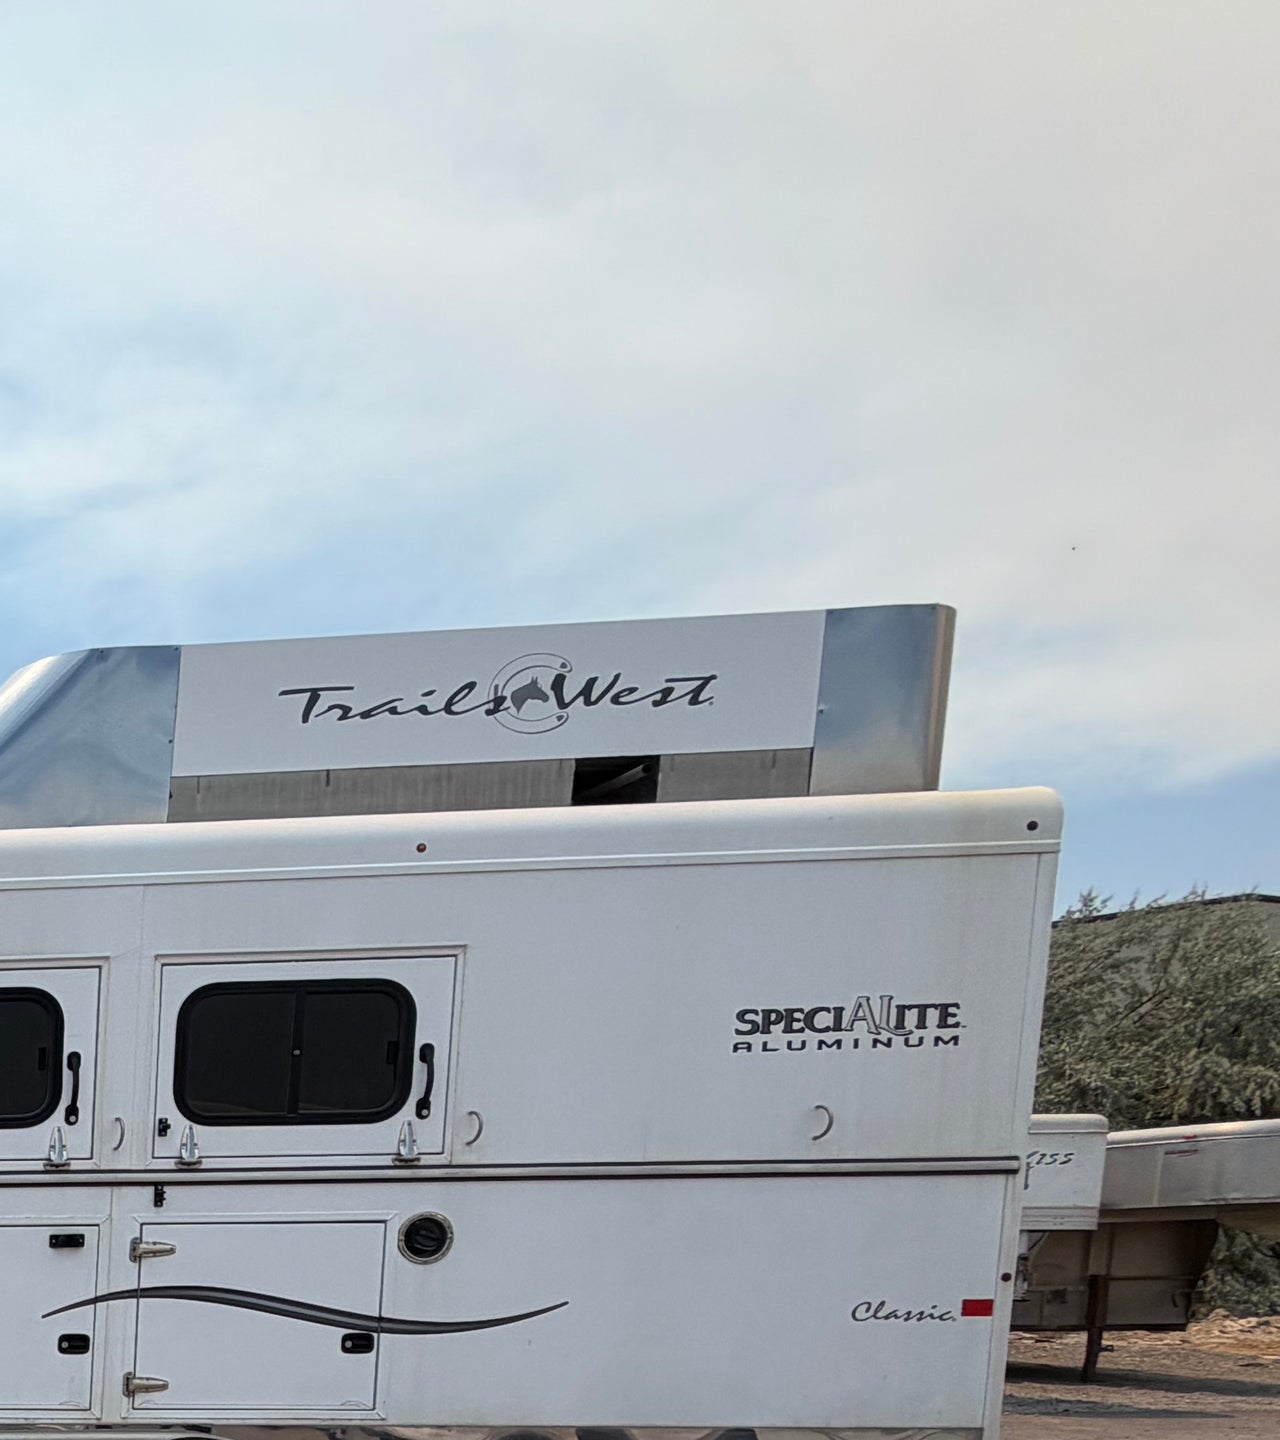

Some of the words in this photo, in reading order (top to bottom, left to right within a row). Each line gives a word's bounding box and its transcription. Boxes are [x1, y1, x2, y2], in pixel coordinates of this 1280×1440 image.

[278, 681, 511, 724] Trails
[550, 672, 718, 711] West
[734, 995, 961, 1036] SPECIALITE
[732, 1035, 960, 1053] ALUMINUM
[851, 1300, 953, 1322] Classic
